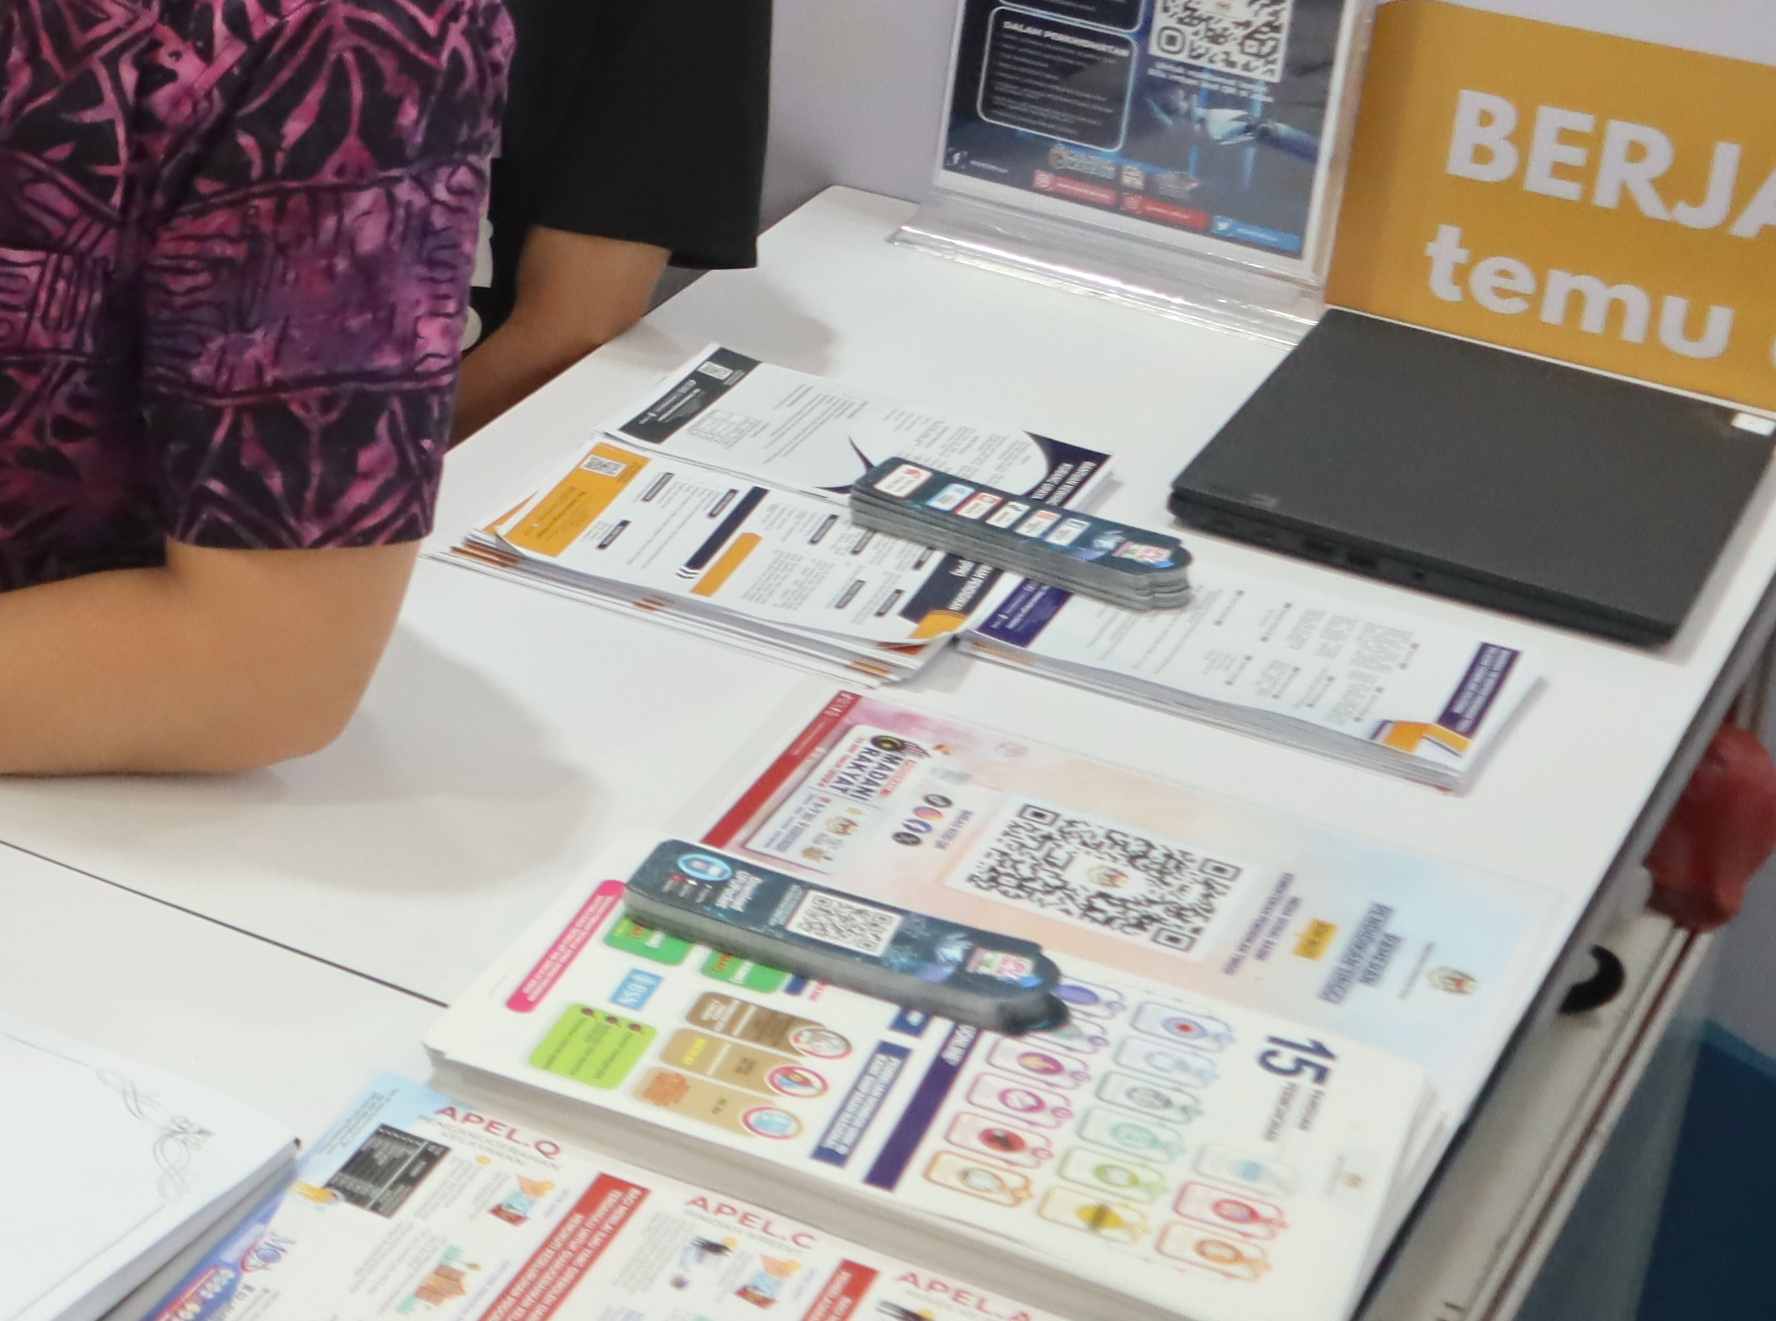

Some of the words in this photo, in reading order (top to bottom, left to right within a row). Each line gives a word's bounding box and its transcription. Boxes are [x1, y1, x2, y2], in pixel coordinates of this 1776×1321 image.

[1425, 223, 1735, 359] temu
[826, 746, 882, 794] RAKYAT
[848, 752, 904, 801] MADANI
[1257, 1035, 1338, 1085] 15
[434, 1105, 562, 1160] APEL.Q
[685, 1194, 819, 1250] APEL.C
